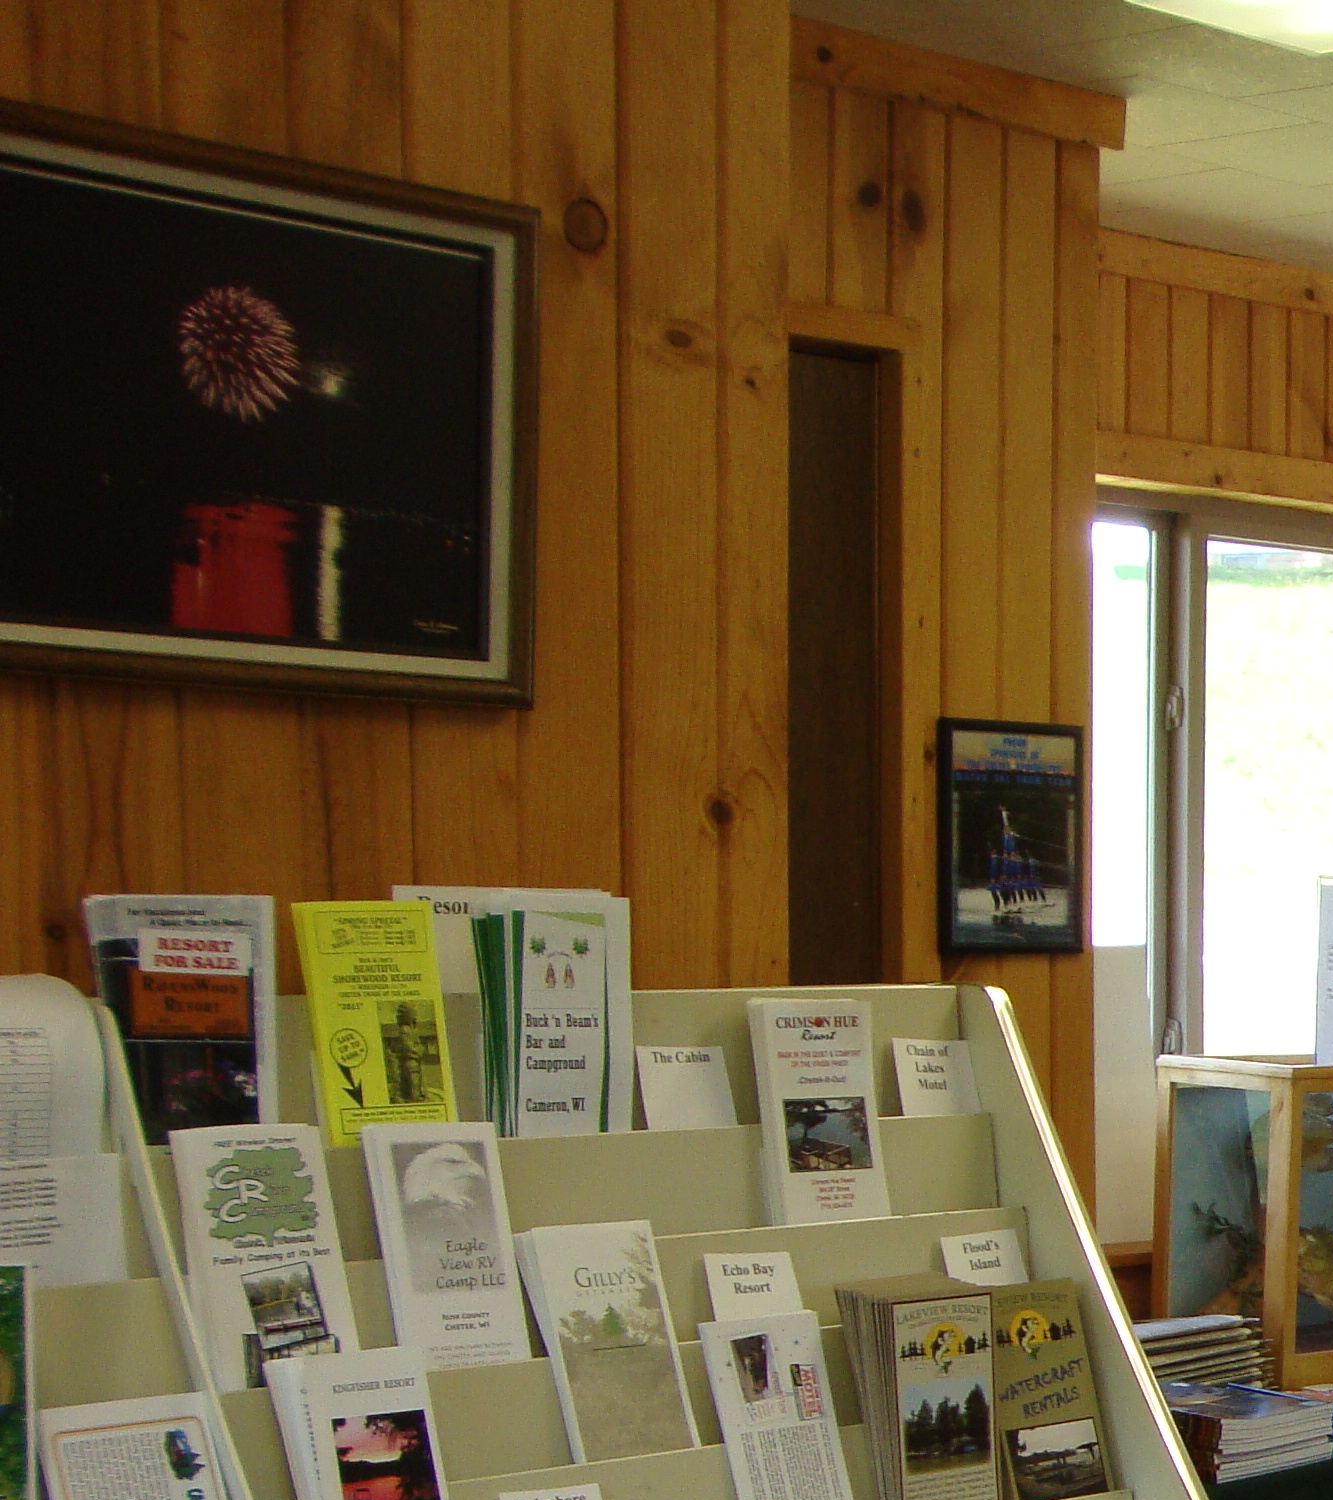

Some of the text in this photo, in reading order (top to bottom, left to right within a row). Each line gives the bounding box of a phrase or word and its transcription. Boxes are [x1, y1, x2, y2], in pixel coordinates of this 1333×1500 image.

[157, 937, 234, 953] RESORT
[153, 955, 239, 970] FOR SALE
[526, 1013, 549, 1028] Buck
[566, 1013, 599, 1028] Beam's
[776, 1015, 859, 1029] CRIMSON HUE
[526, 1035, 566, 1049] Bar and
[652, 1050, 711, 1064] The Cabin
[906, 1044, 949, 1057] Chain of
[526, 1055, 586, 1074] Campground
[915, 1062, 944, 1074] Lakes
[918, 1078, 947, 1090] Motel
[526, 1097, 586, 1113] Cameron, WI
[446, 1238, 488, 1256] Eagle
[962, 1240, 999, 1254] Flood's
[440, 1256, 496, 1270] View RV
[722, 1263, 774, 1277] Echo Bay
[969, 1257, 1001, 1270] Island
[436, 1273, 506, 1291] Camp LLC
[574, 1267, 636, 1288] GILLY'S
[733, 1282, 771, 1294] Resort
[951, 1304, 988, 1317] RESORT
[384, 1377, 415, 1390] RESORT
[998, 1357, 1084, 1403] WATERCRAFT
[1022, 1387, 1080, 1418] RENTALS
